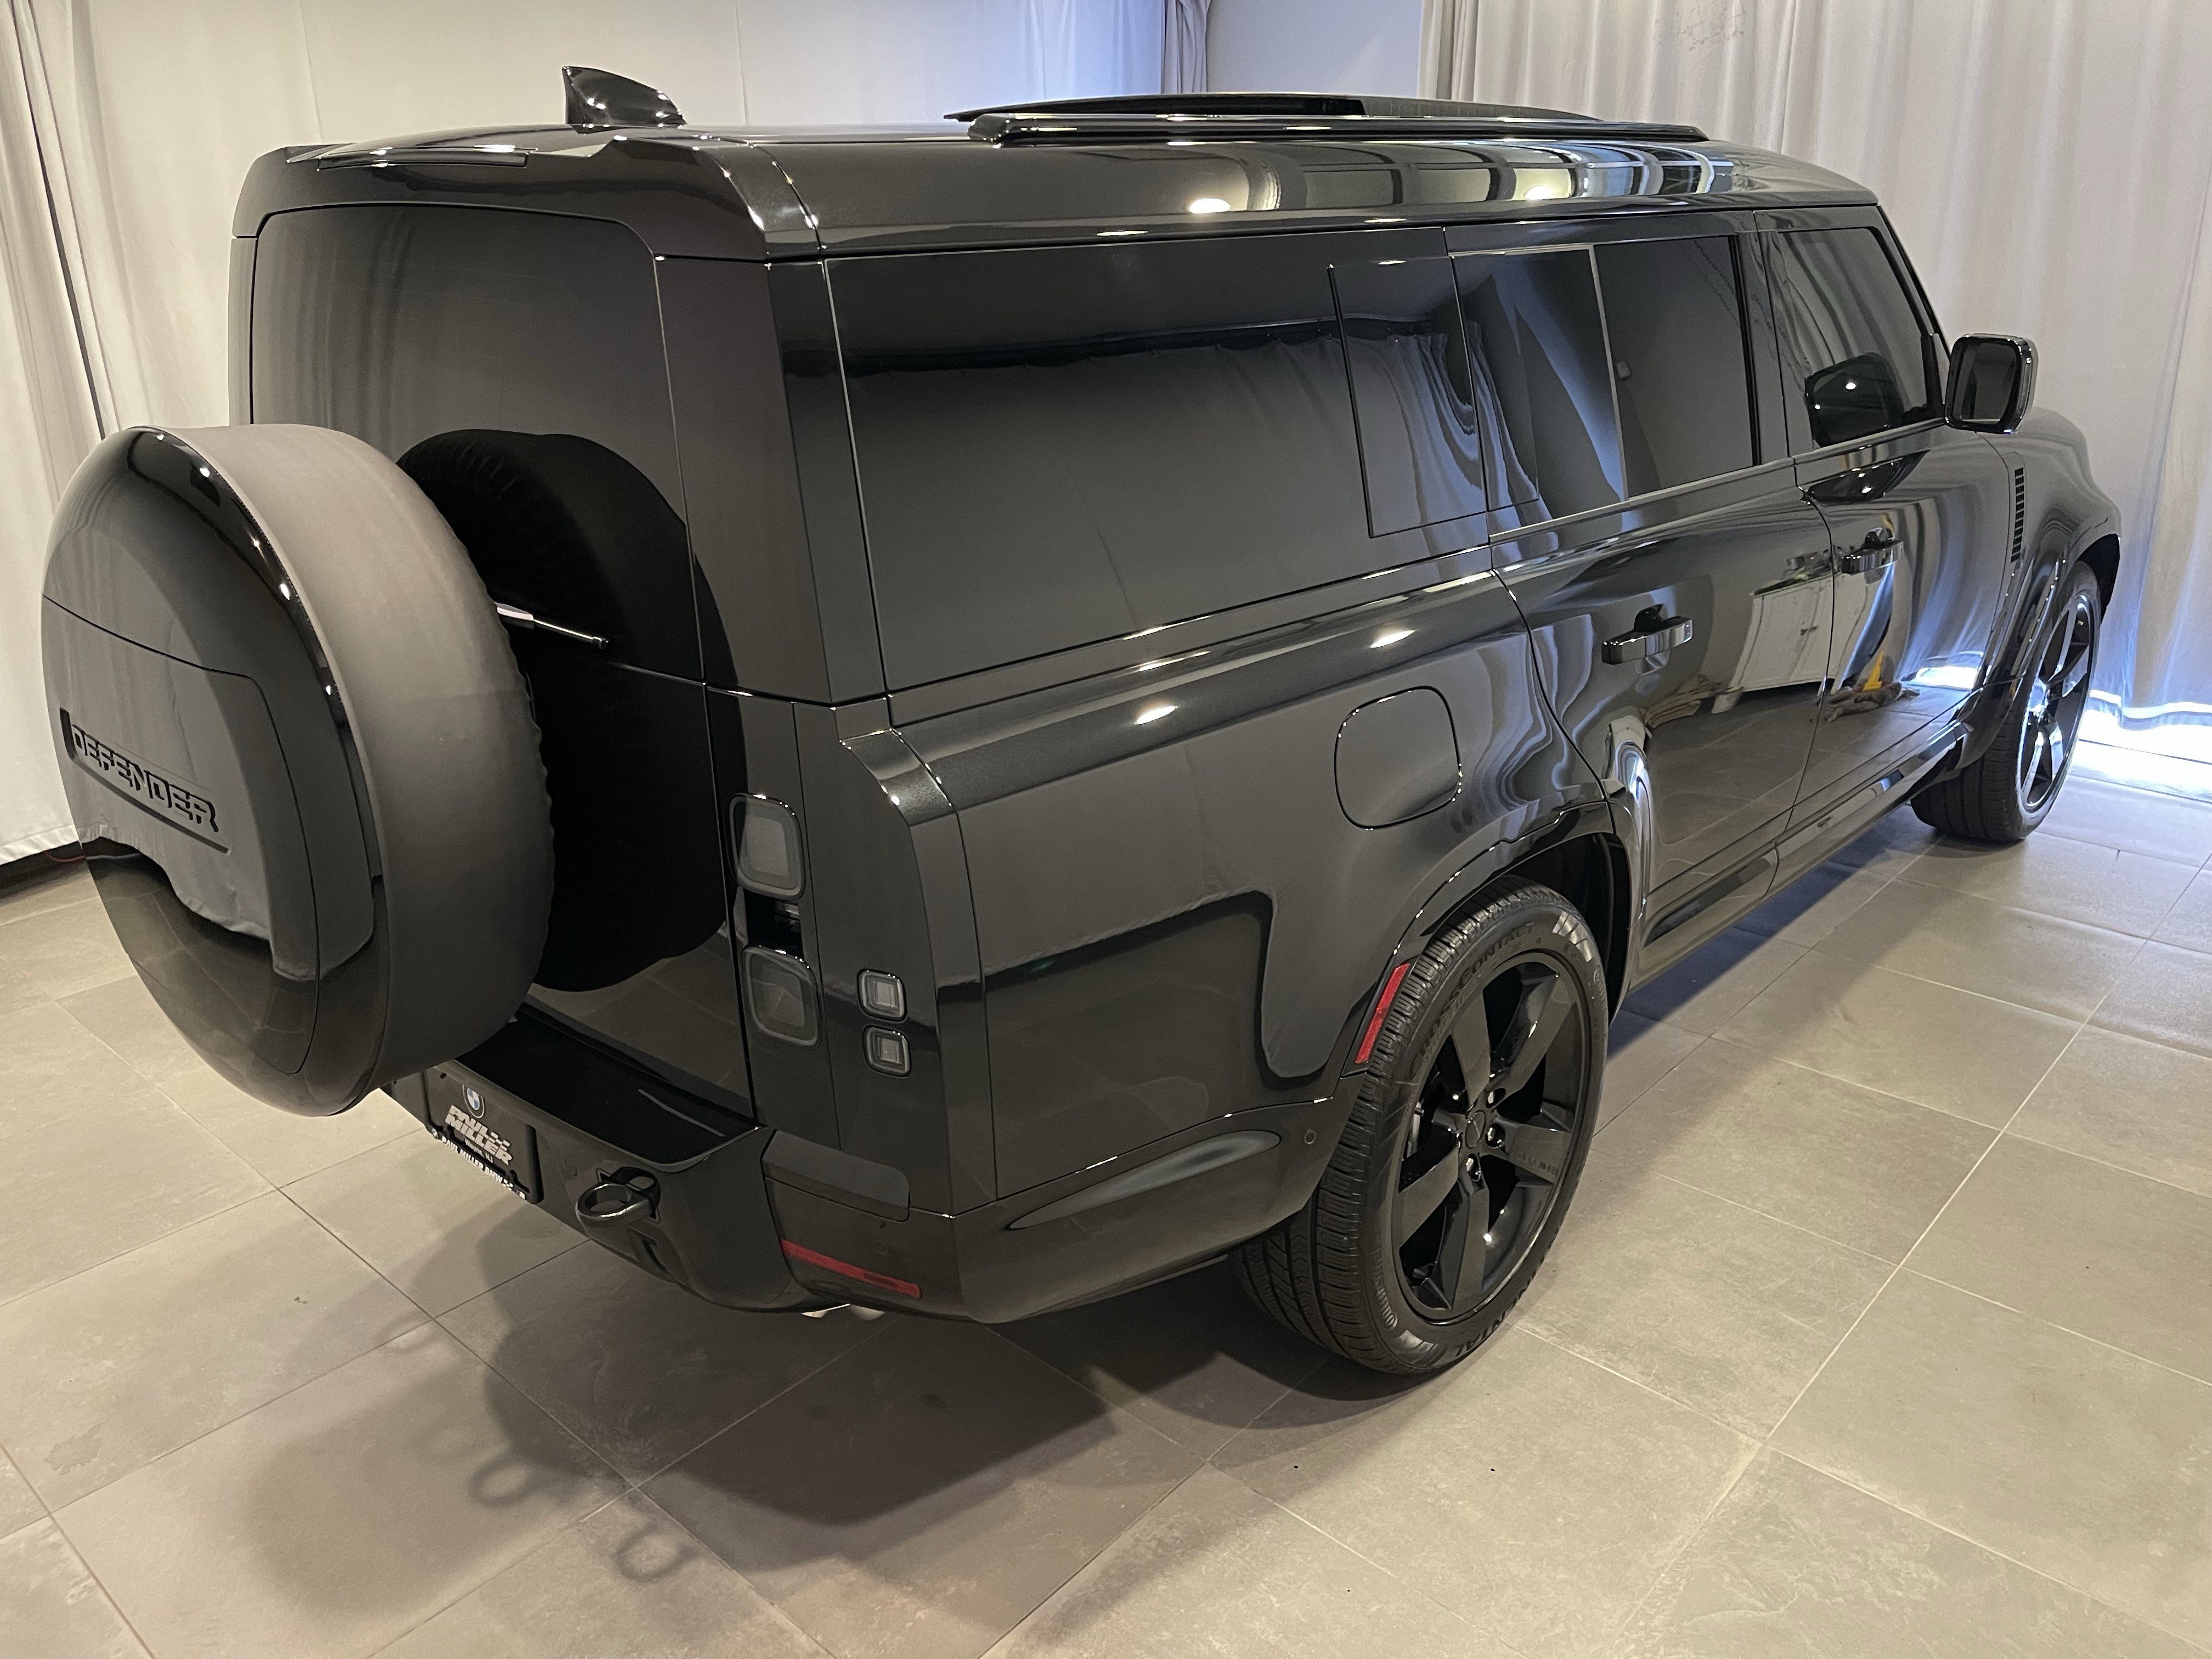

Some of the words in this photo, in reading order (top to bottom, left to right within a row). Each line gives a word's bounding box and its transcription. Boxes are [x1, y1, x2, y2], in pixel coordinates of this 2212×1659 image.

[71, 724, 219, 833] DEFENDER
[445, 1113, 512, 1165] MILLER
[448, 1104, 490, 1138] PAUL
